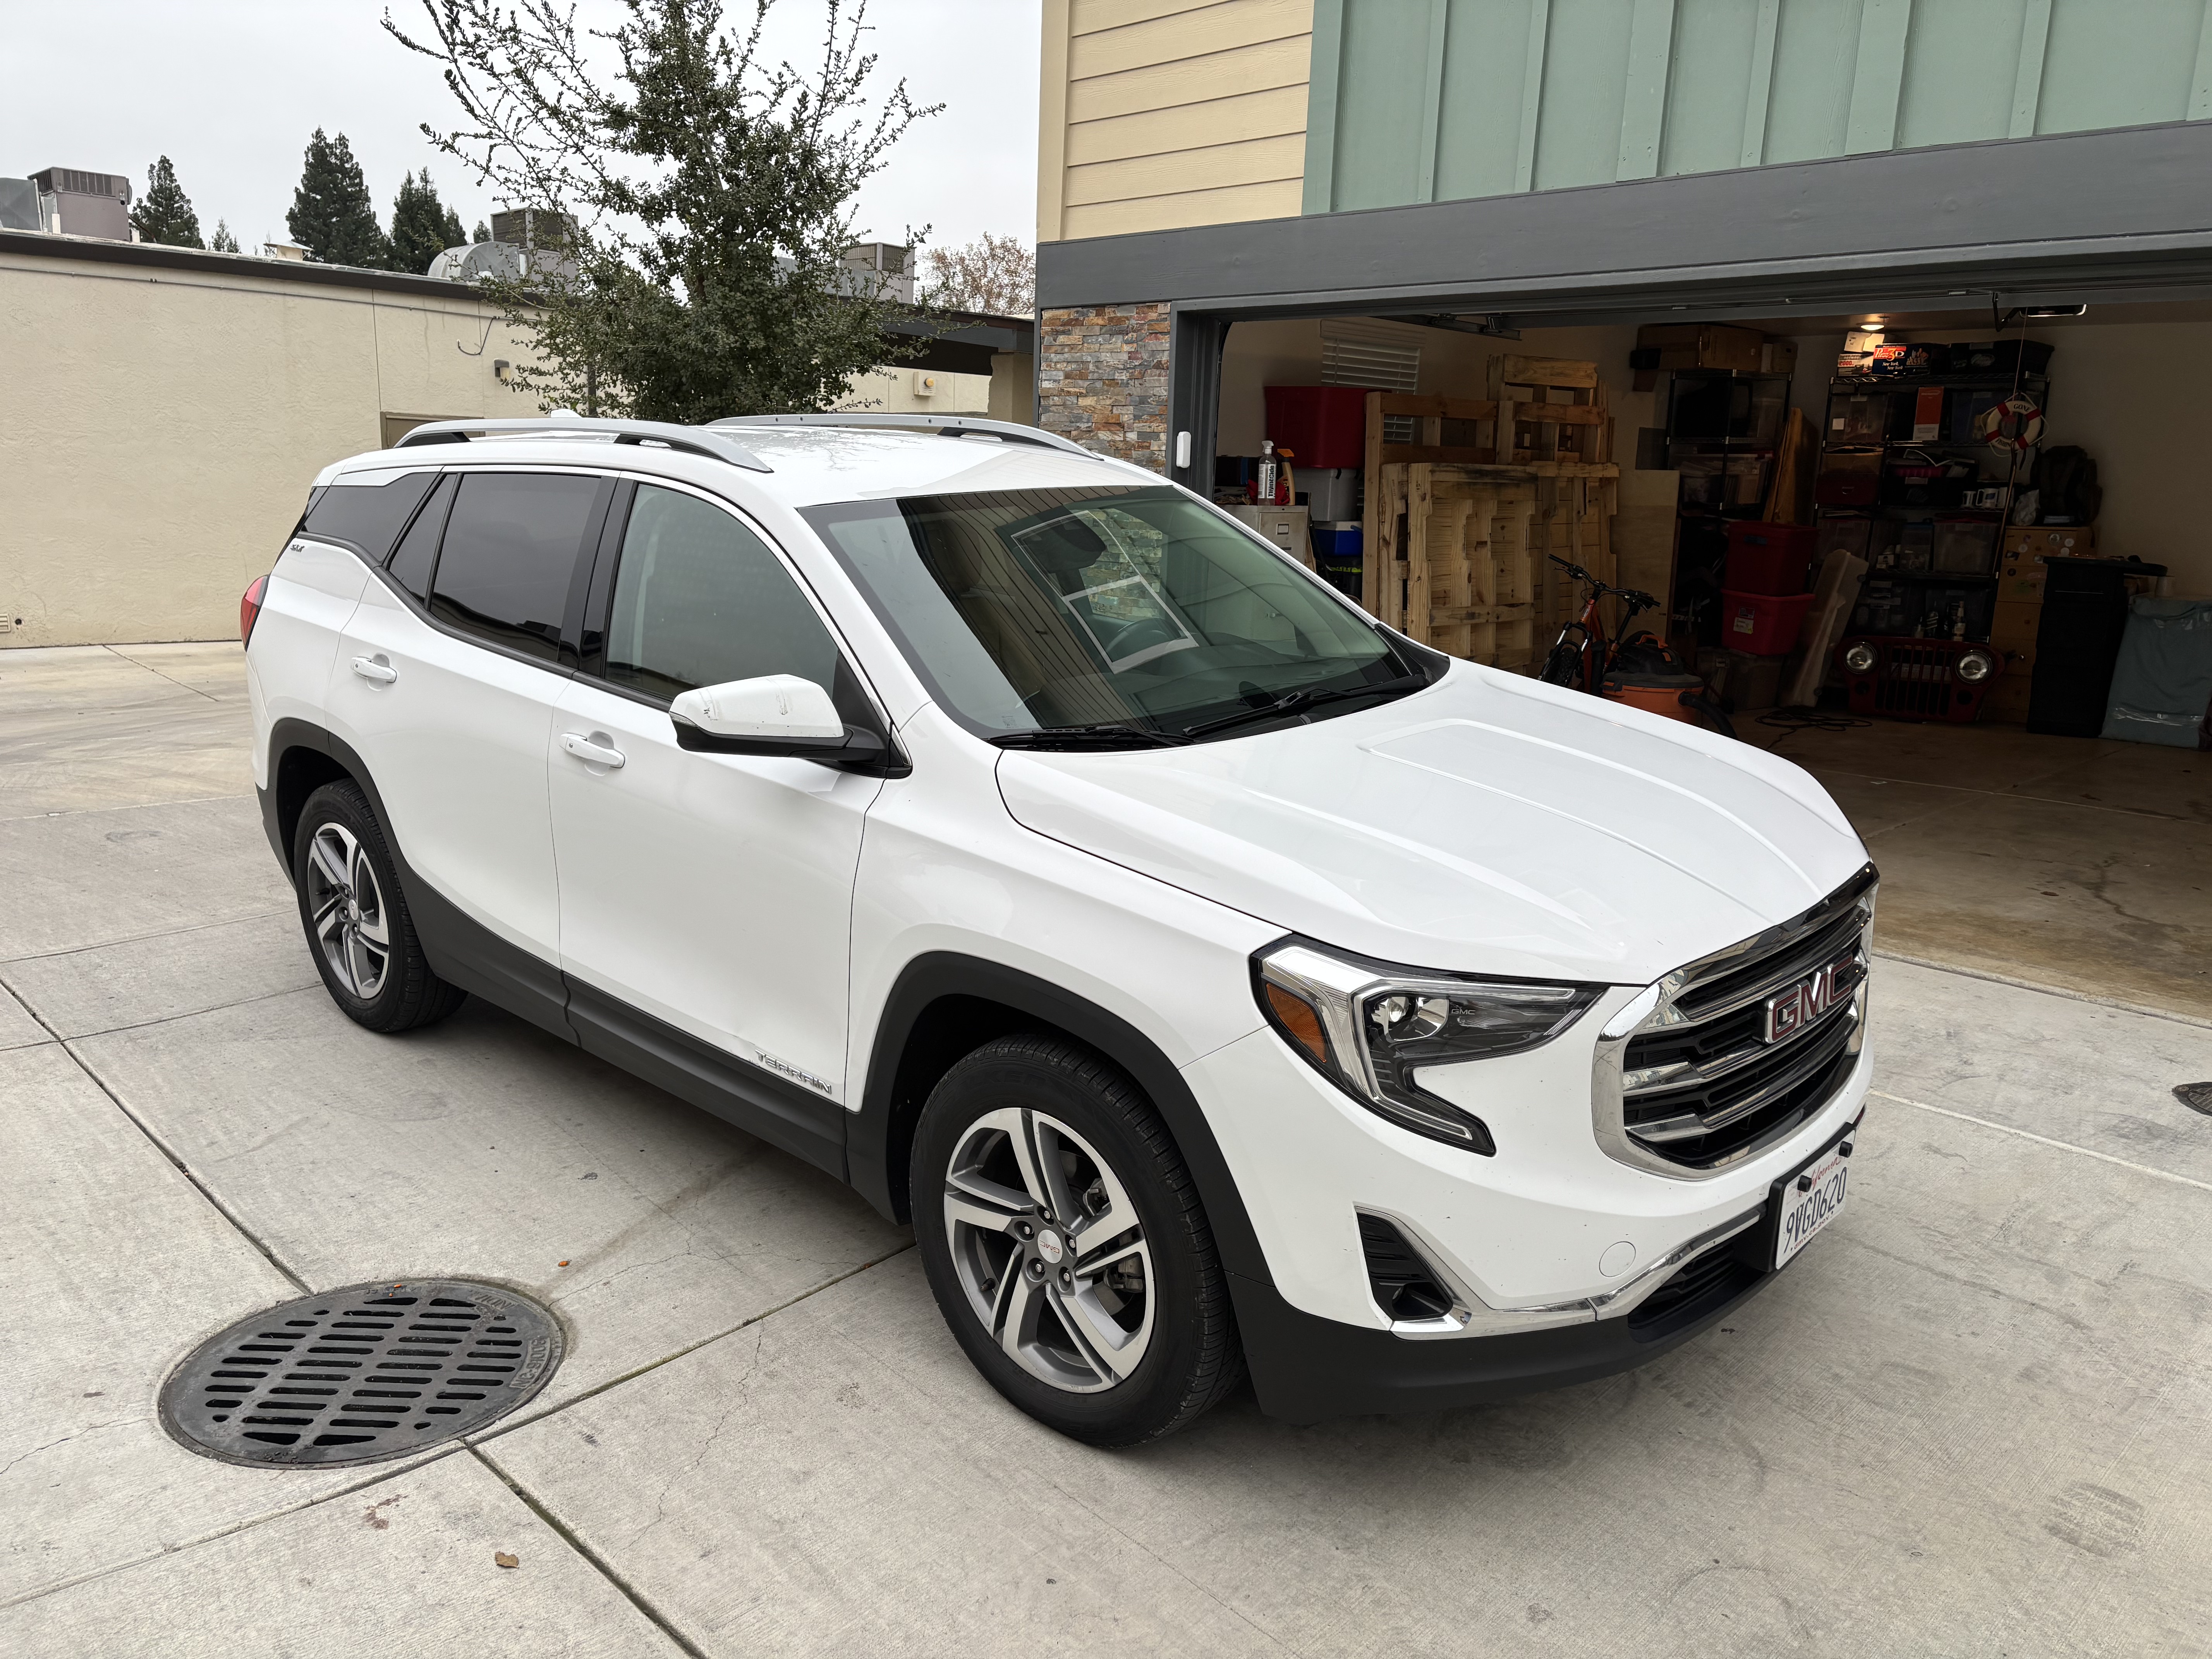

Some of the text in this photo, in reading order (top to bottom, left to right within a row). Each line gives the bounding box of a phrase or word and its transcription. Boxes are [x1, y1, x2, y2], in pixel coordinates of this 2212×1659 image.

[2014, 404, 2030, 412] GONE
[1764, 952, 1853, 1045] GMC
[755, 1048, 832, 1094] TERRAIN
[1784, 1166, 1847, 1254] 9VGD620
[1039, 1240, 1060, 1254] GMC
[1794, 1215, 1829, 1250] dmv.ca.gov
